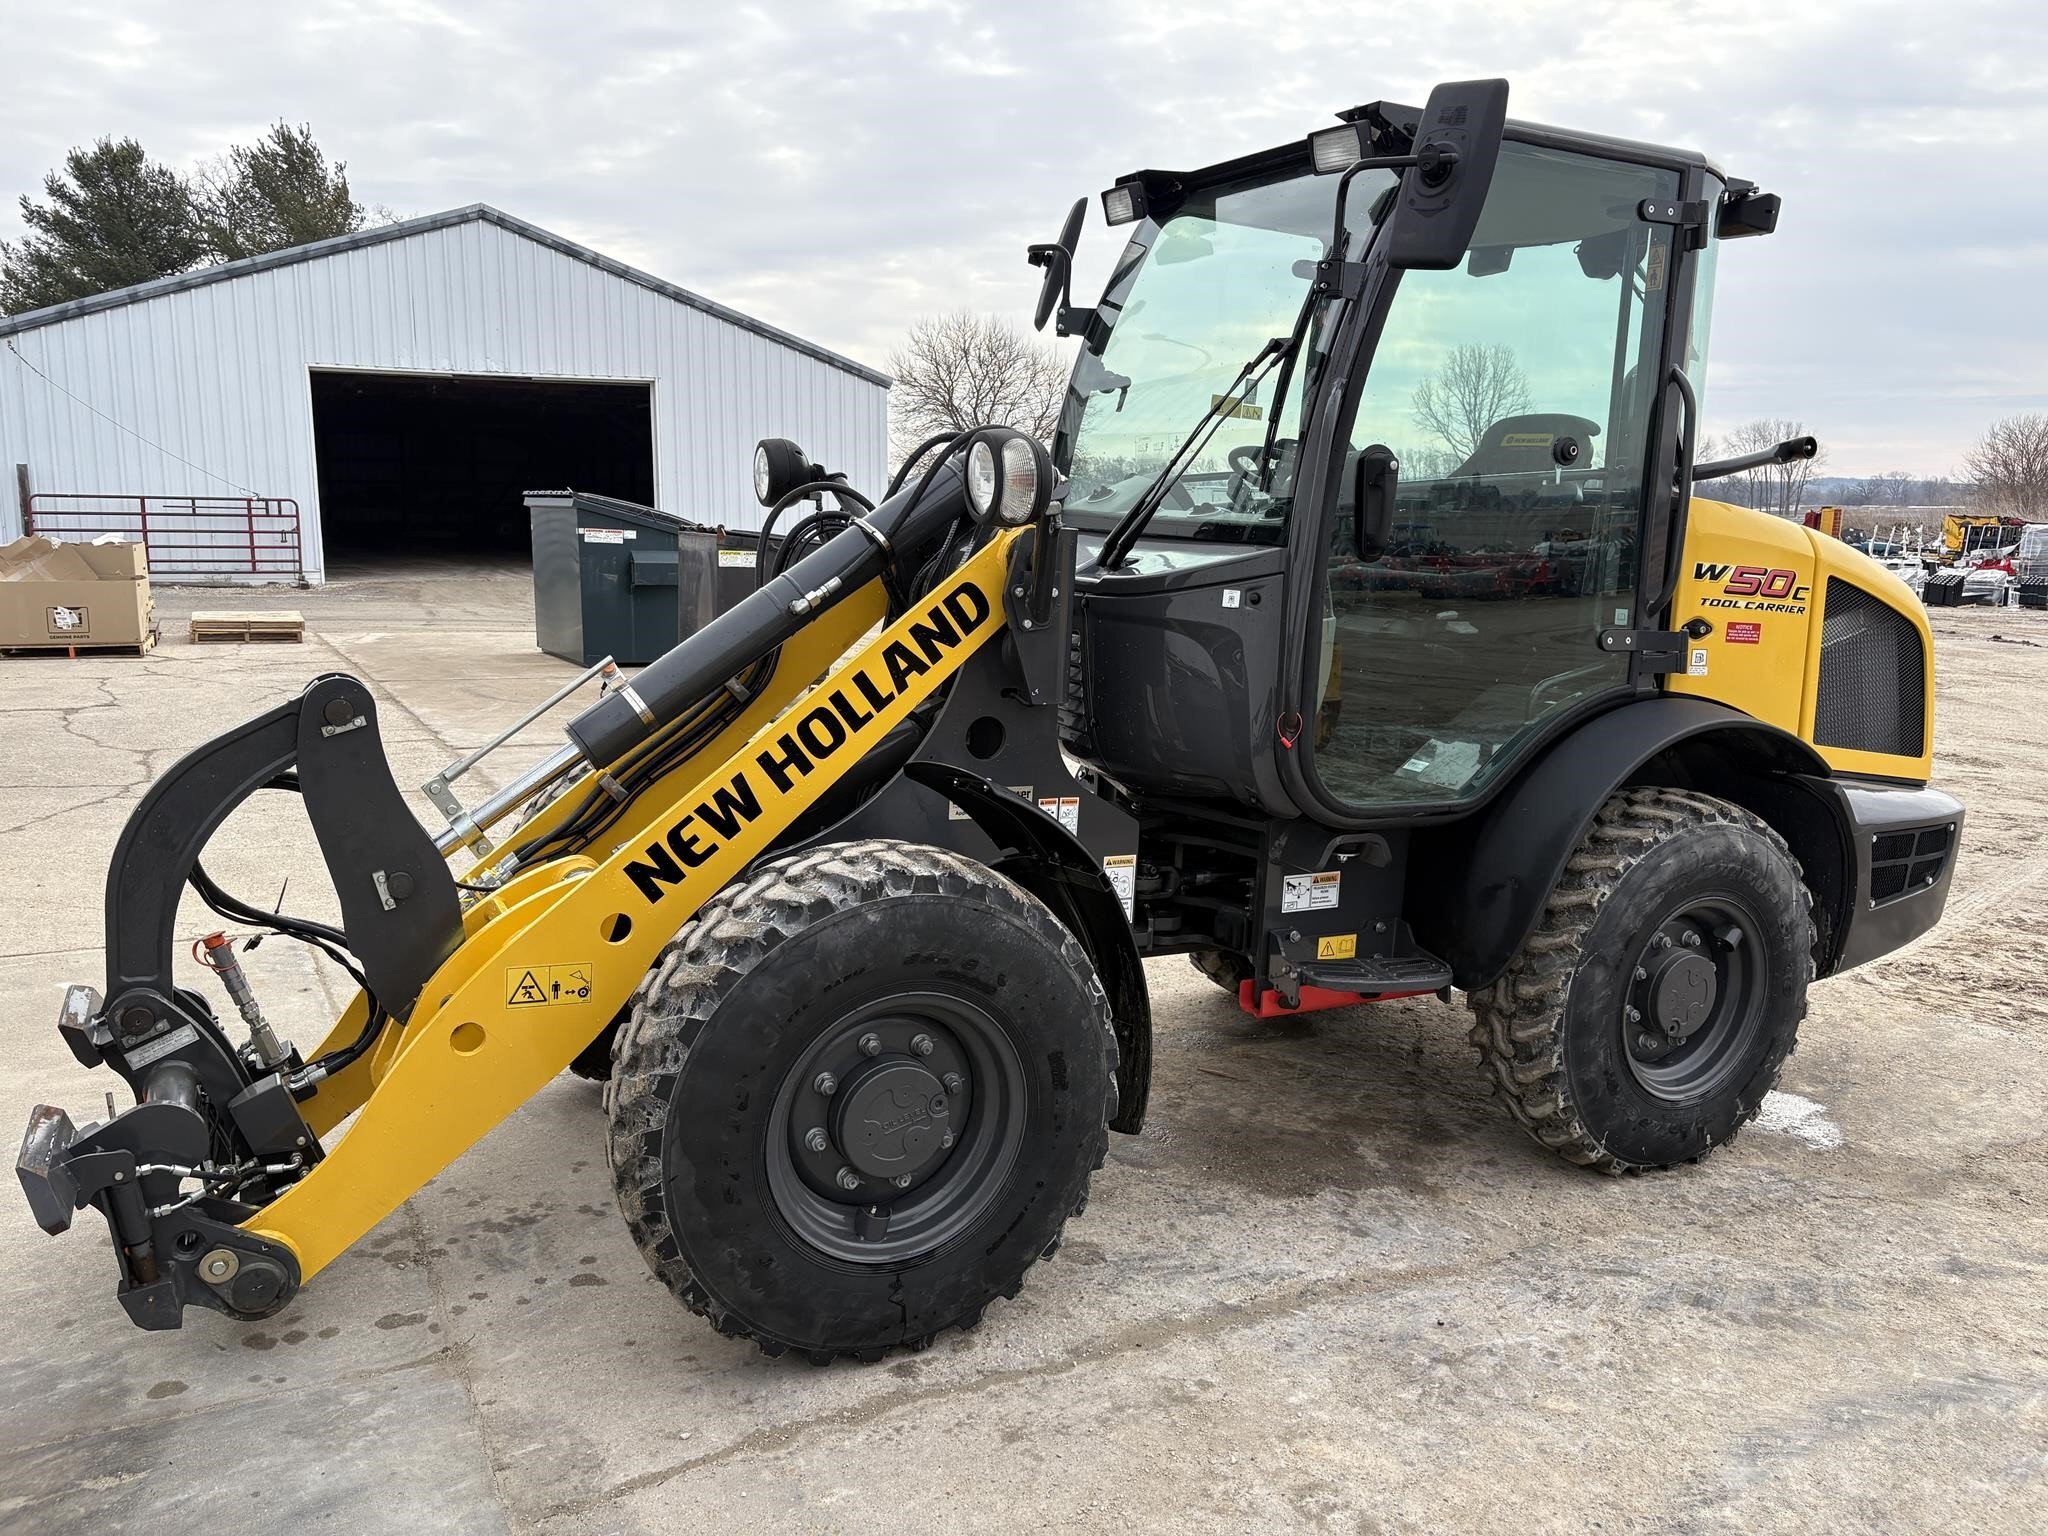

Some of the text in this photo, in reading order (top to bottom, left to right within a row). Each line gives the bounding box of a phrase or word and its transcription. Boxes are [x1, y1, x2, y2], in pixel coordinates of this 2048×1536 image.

[1700, 598, 1806, 615] TOOL CARRIER
[623, 582, 990, 904] NEW HOLLAND
[1112, 858, 1134, 866] WARNING
[1319, 875, 1337, 883] WARNING
